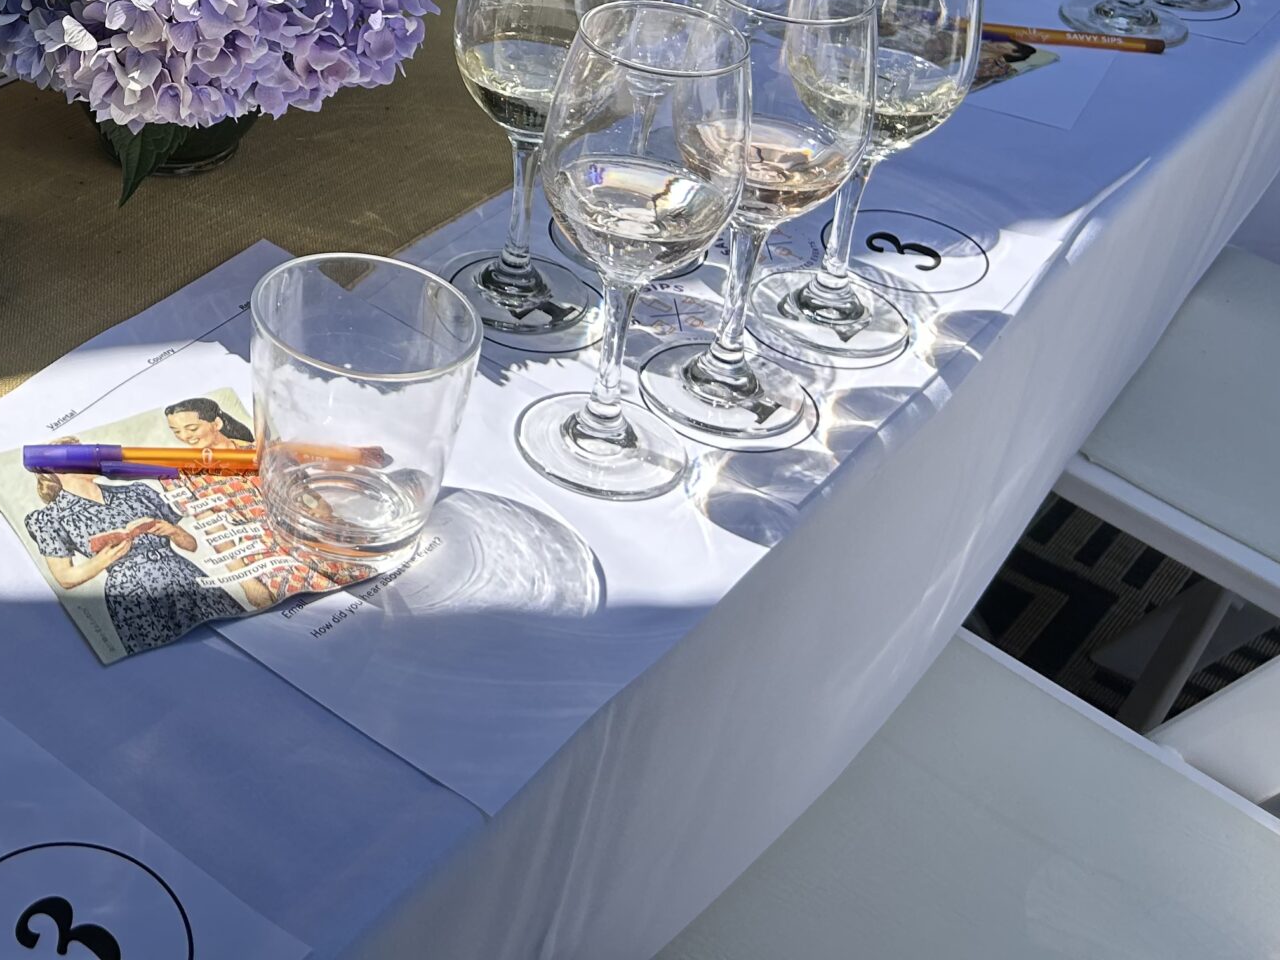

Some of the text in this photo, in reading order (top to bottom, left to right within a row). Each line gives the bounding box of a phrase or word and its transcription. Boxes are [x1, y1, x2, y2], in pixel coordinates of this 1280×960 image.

[1065, 33, 1098, 42] SAVVY
[866, 231, 942, 271] 3
[642, 283, 685, 293] SIPS
[47, 409, 78, 431] Varietal
[147, 347, 176, 366] Country
[171, 490, 188, 499] see
[190, 496, 224, 511] you've
[194, 512, 228, 530] already
[206, 524, 261, 546] penciled in
[201, 578, 216, 587] for
[217, 562, 266, 583] tomorrow
[281, 599, 307, 619] Email
[310, 620, 333, 639] How
[332, 610, 348, 625] did
[346, 599, 364, 616] you
[360, 584, 382, 602] hear
[380, 567, 405, 588] about
[15, 895, 122, 960] 3
